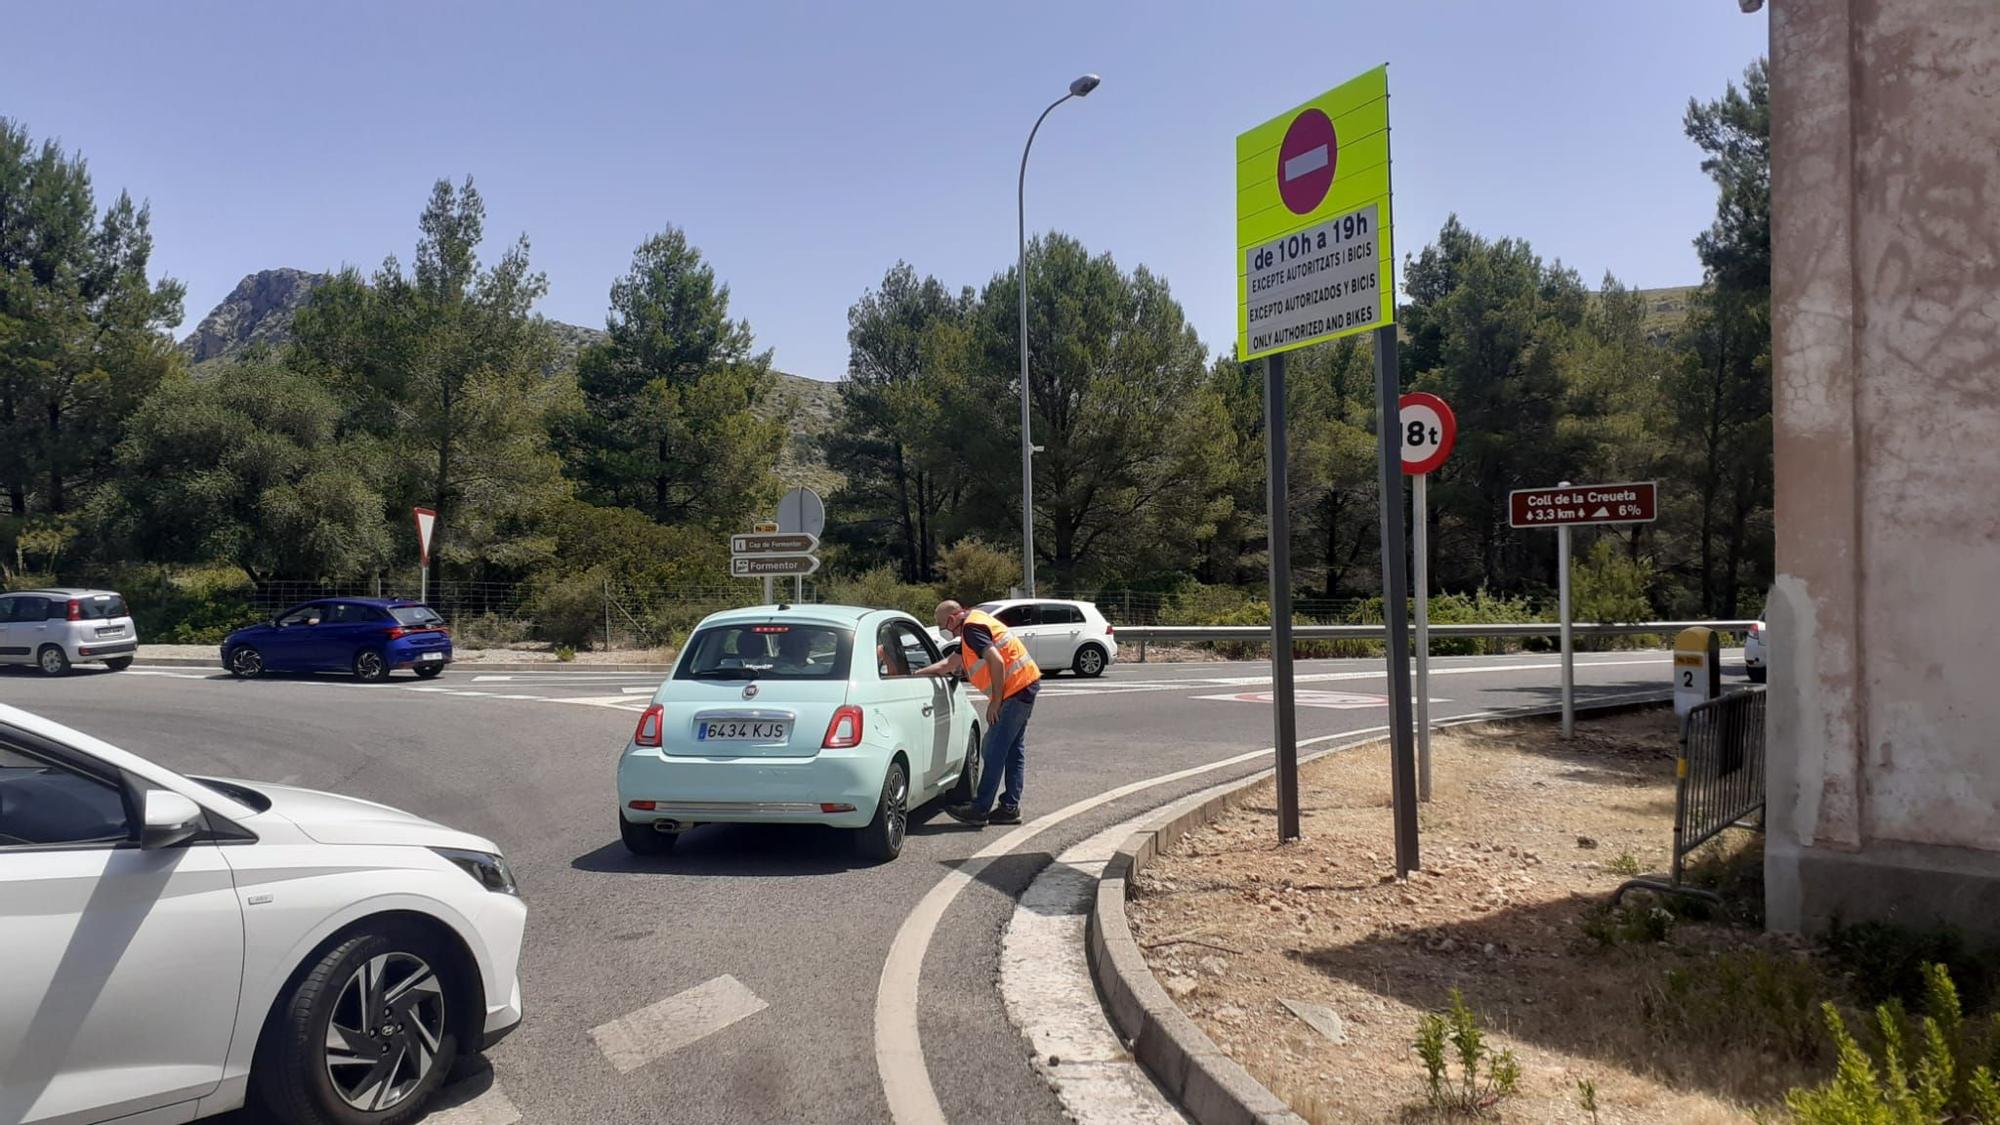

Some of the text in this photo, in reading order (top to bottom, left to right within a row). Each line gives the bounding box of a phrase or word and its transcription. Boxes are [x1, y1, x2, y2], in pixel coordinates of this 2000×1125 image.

[1254, 213, 1367, 271] de 10h a 19h
[1252, 242, 1372, 293] EXCEPTE AUTORITZATS I BICIS
[1249, 273, 1376, 322] EXCEPTO AUTORIZADOS Y BICIS
[1253, 305, 1373, 350] ONLY AUTHORIZED AND BIKES
[1527, 490, 1636, 506] Coll de la Creueta
[1557, 508, 1575, 519] km
[750, 561, 798, 571] Formentor
[1683, 671, 1693, 688] 2
[708, 724, 784, 737] 6434 KJS
